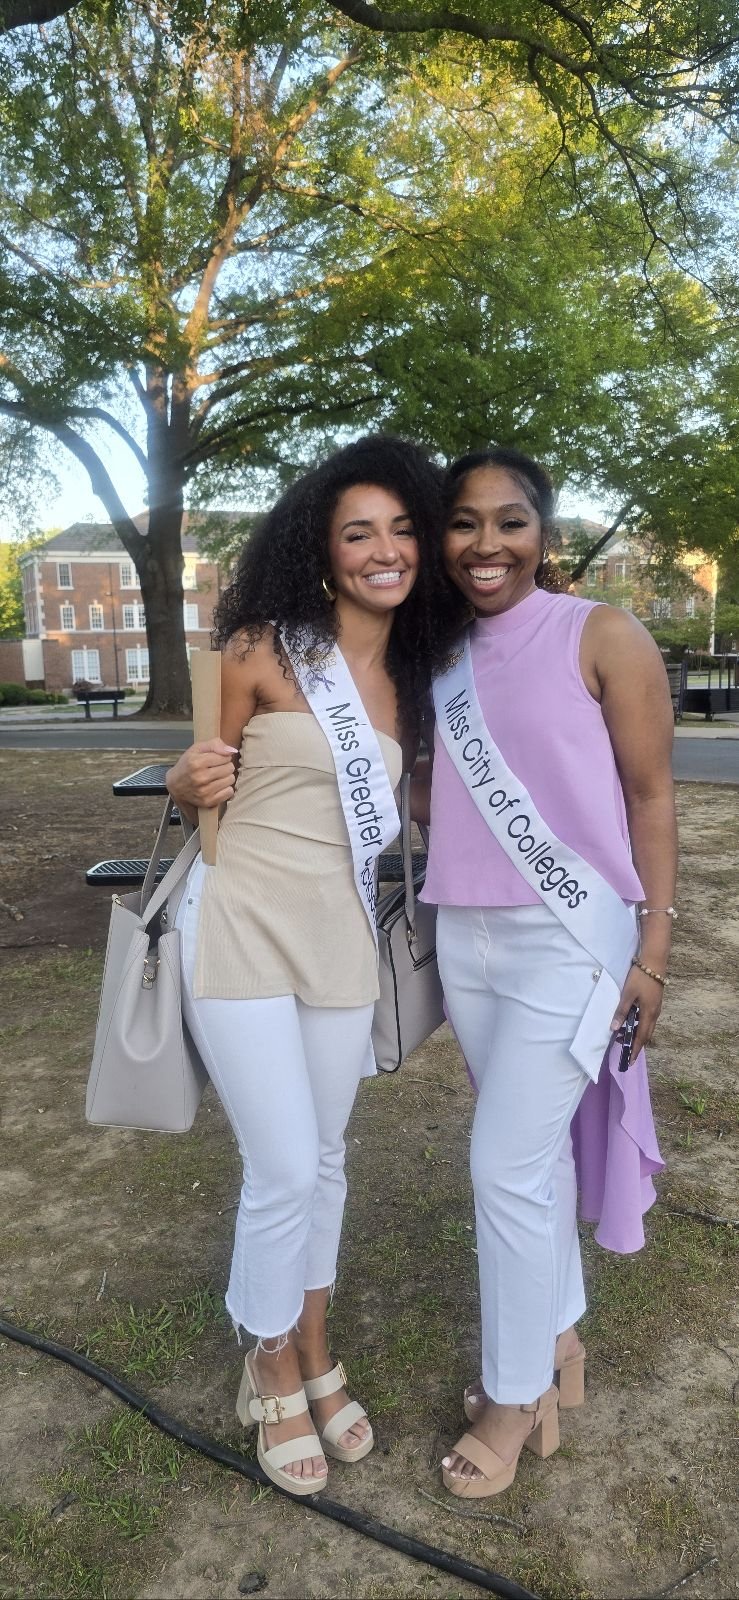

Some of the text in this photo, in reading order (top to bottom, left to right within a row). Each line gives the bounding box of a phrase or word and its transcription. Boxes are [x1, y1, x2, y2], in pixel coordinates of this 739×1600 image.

[325, 702, 360, 752] Miss
[345, 757, 384, 848] Greater
[444, 688, 471, 741] Miss
[462, 737, 495, 789] City
[488, 789, 521, 816] of
[507, 814, 588, 909] Colleges
